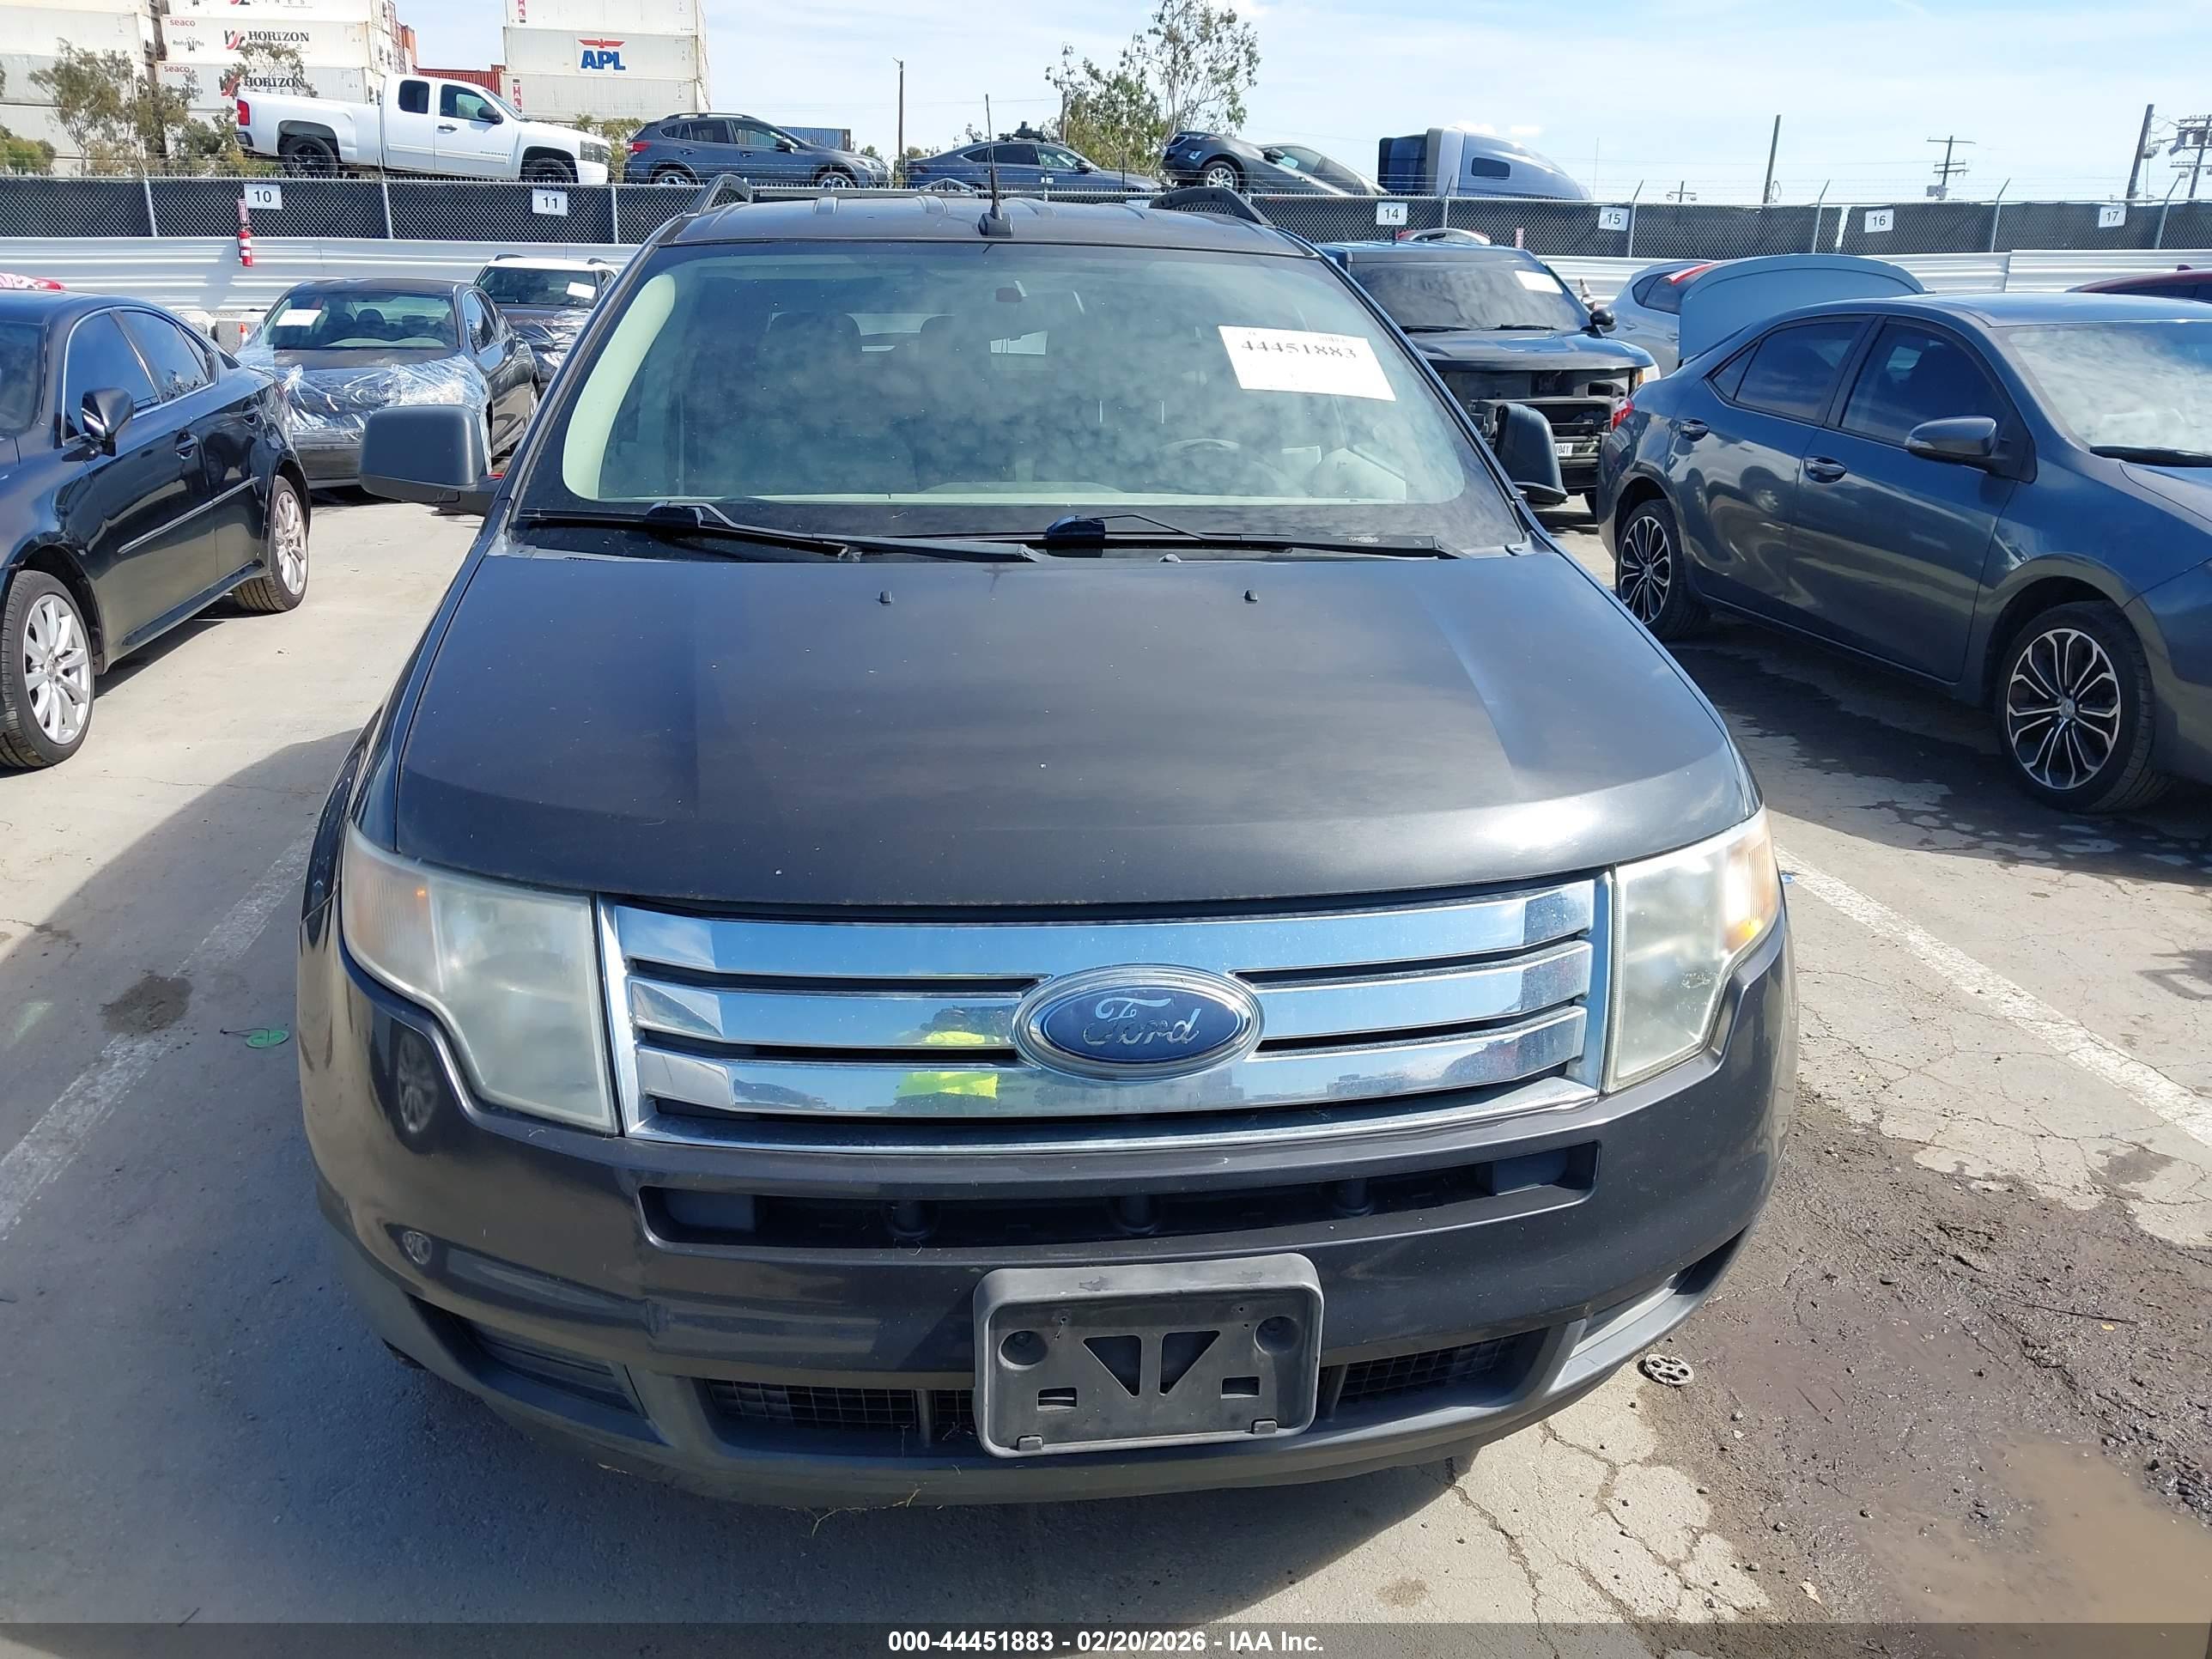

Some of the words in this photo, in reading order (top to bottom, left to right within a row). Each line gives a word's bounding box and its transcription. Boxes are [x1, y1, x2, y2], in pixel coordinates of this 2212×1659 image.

[248, 31, 309, 41] HORIZON
[580, 50, 626, 70] APL
[254, 190, 272, 204] 10
[543, 196, 558, 210] 11
[1384, 208, 1400, 220] 14
[1607, 212, 1621, 225] 15
[2106, 210, 2119, 222] 17
[1872, 215, 1887, 228] 16
[1242, 340, 1357, 358] 44451883
[1083, 996, 1201, 1046] Ford
